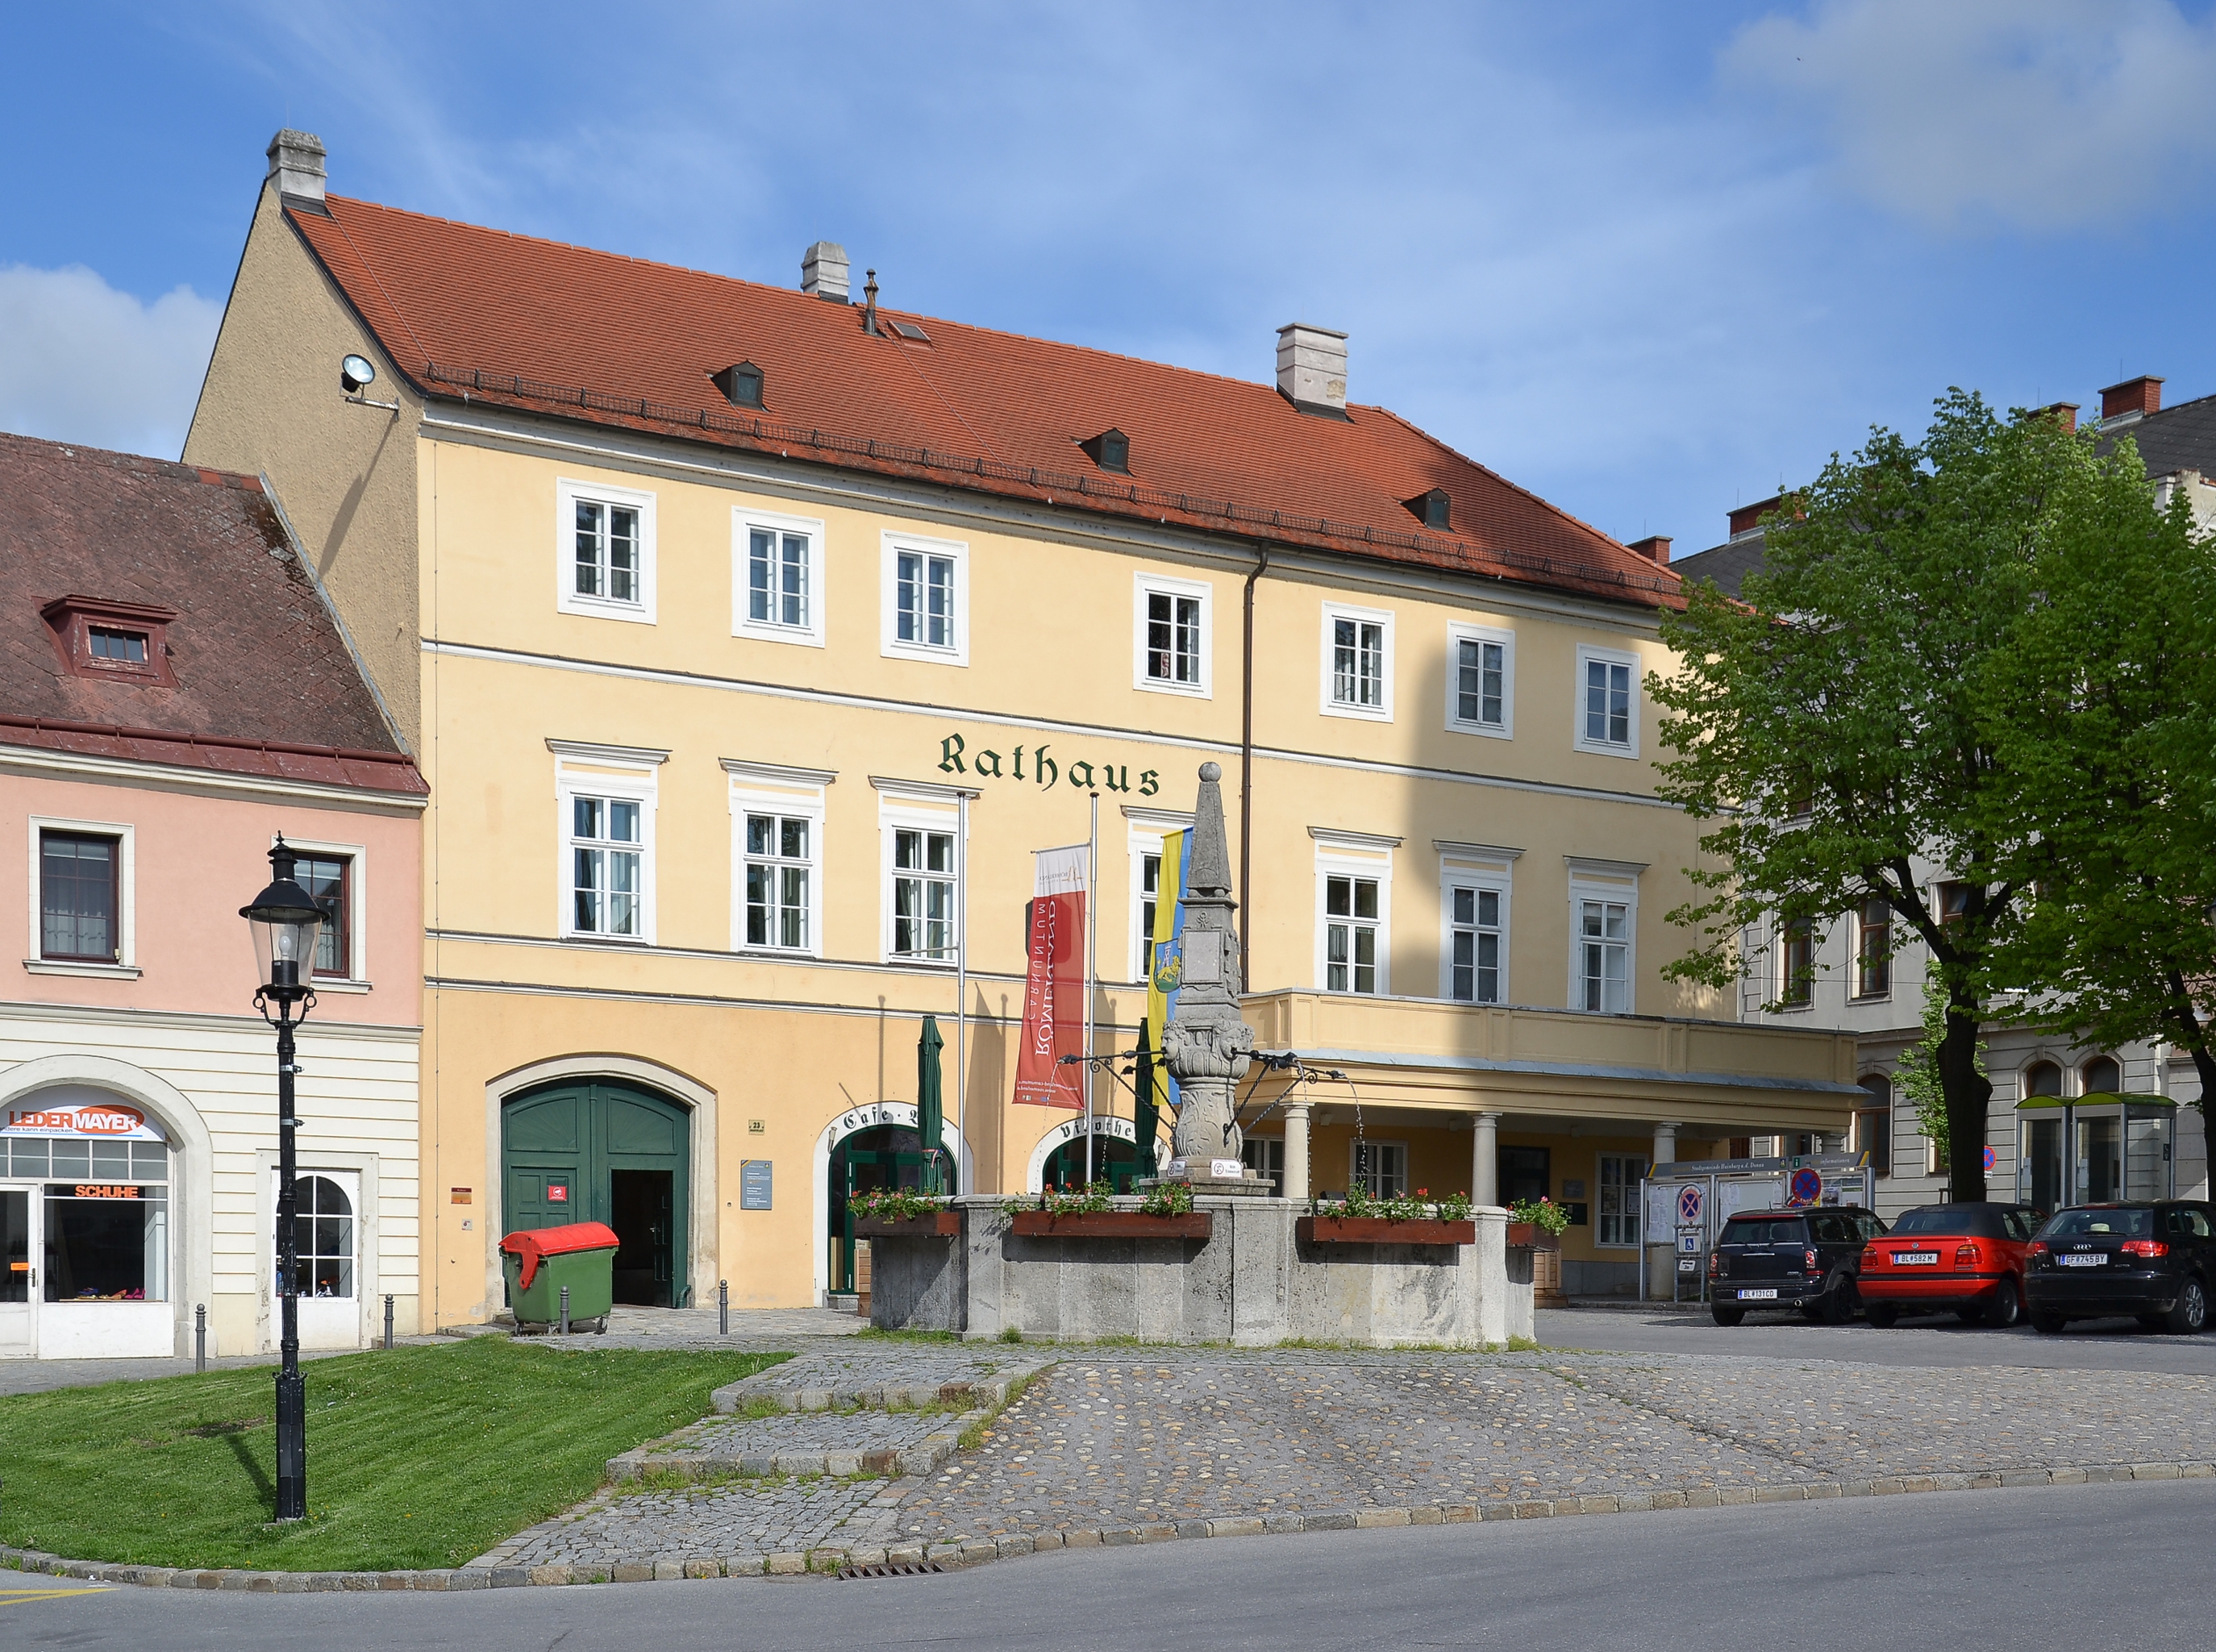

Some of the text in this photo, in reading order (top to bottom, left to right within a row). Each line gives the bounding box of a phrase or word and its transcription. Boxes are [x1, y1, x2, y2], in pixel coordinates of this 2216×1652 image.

[937, 733, 1160, 797] Rathaus
[843, 1106, 889, 1129] Cafe
[1060, 1119, 1132, 1138] Viothe
[74, 1184, 139, 1199] SCHUHE
[2066, 1255, 2076, 1263] GF
